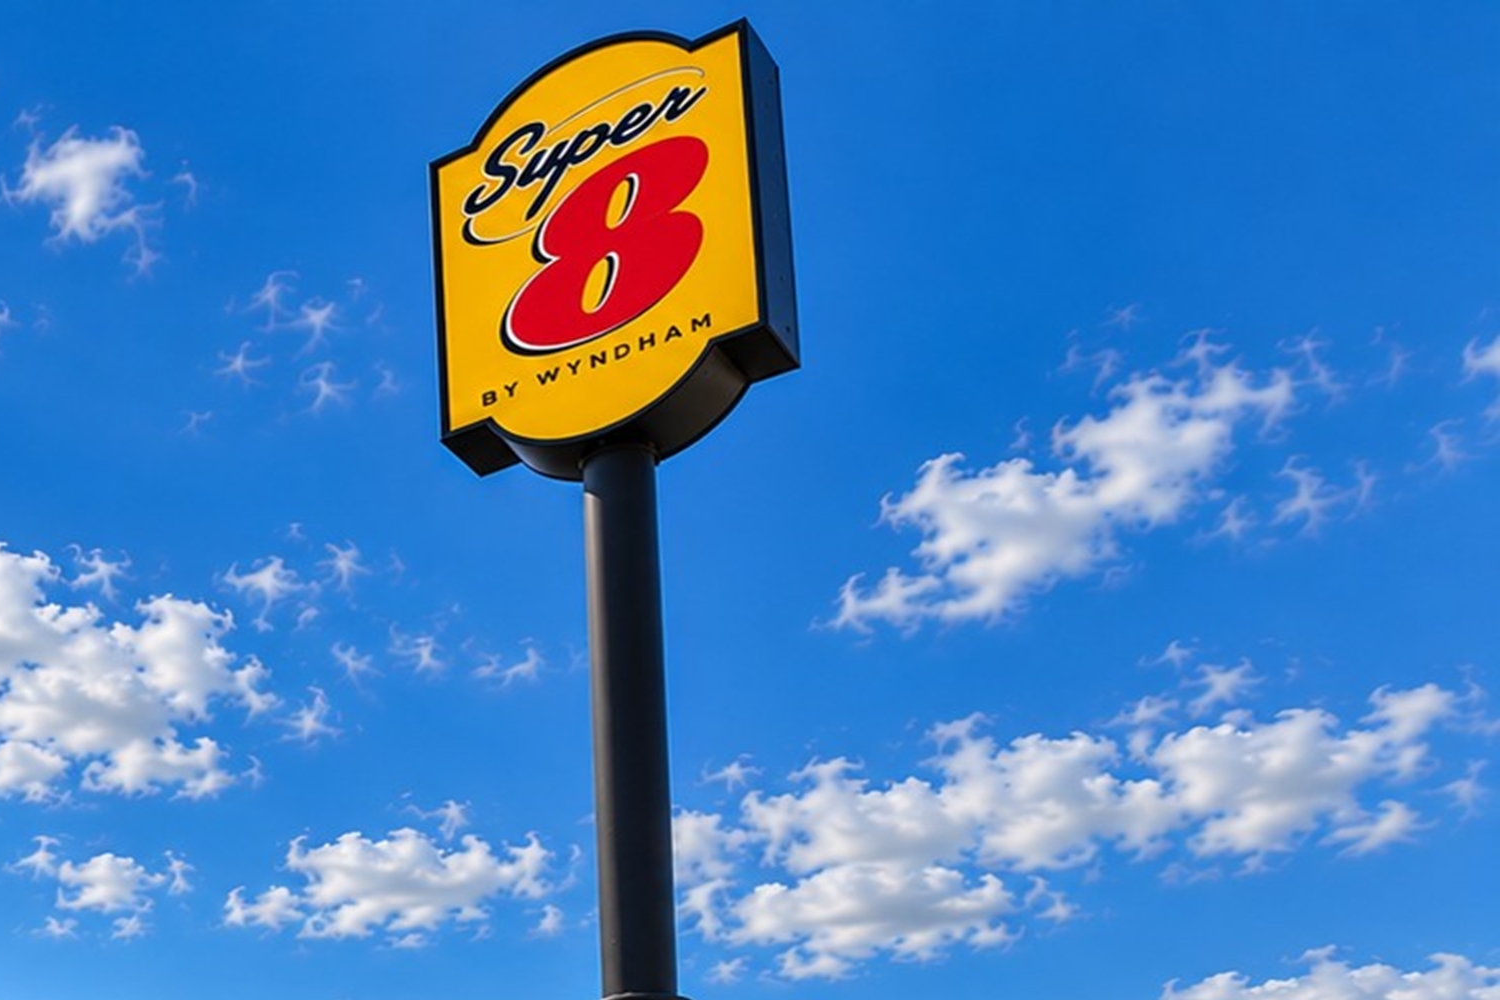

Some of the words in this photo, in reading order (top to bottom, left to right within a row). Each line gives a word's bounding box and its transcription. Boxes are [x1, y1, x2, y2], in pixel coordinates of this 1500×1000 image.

[463, 84, 708, 222] Super
[500, 135, 710, 357] 8
[481, 382, 519, 407] BY
[537, 312, 713, 386] WYNDHAM
